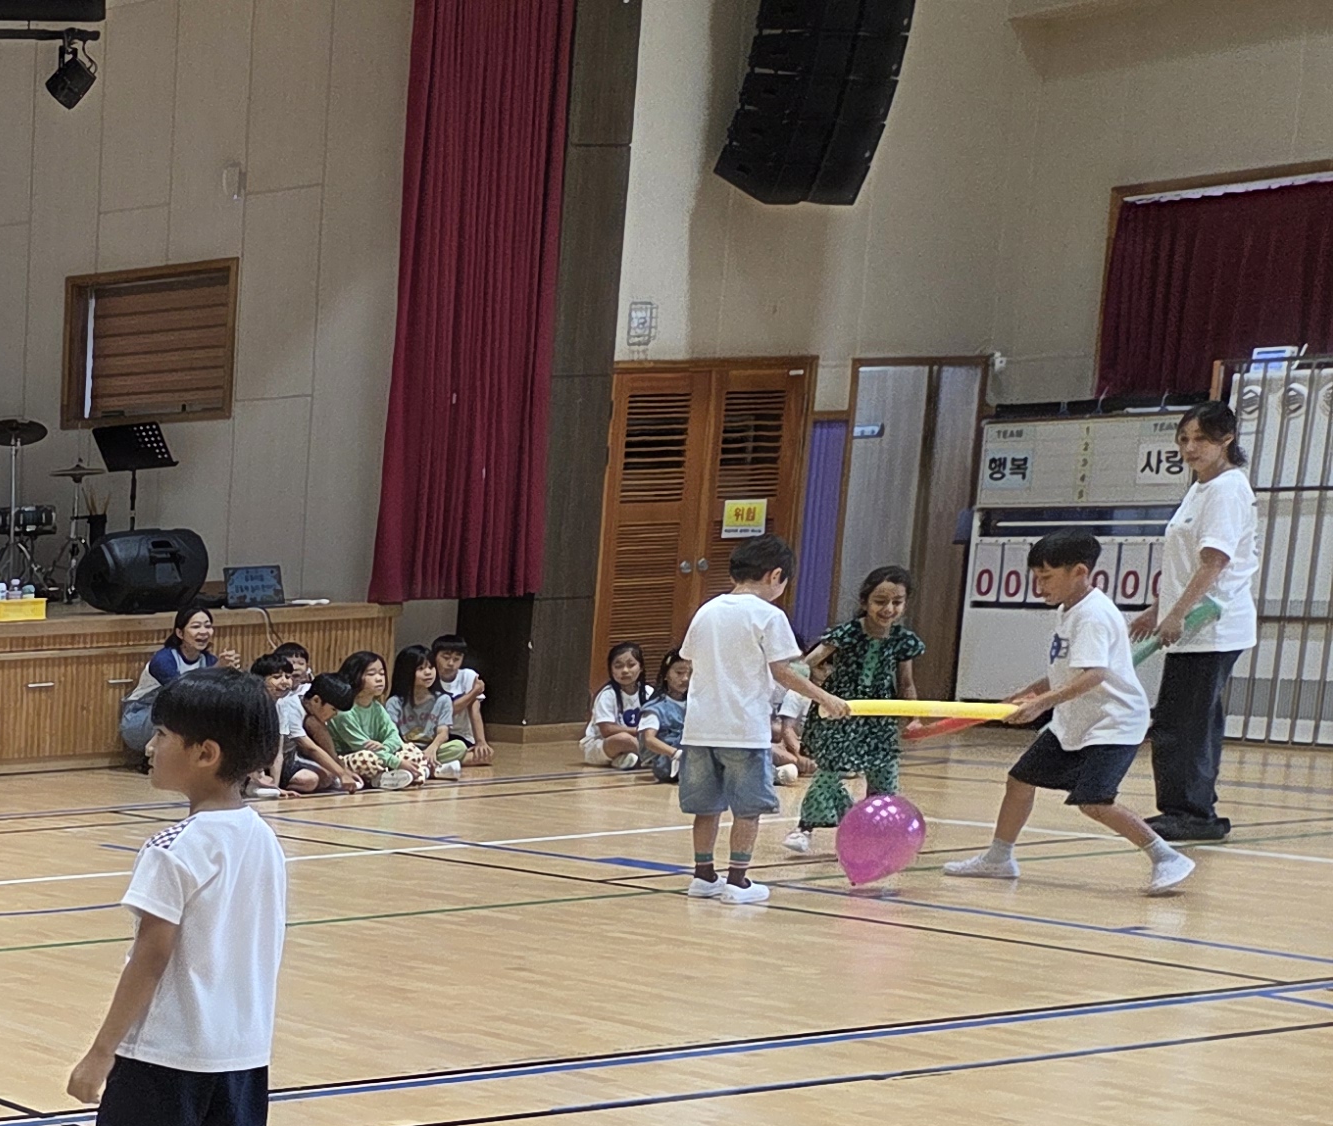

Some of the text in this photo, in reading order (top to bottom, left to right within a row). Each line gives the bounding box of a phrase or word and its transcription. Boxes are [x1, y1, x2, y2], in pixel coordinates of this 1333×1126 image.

[996, 429, 1024, 440] TEAM
[988, 455, 1028, 481] 행복
[1140, 449, 1184, 475] 사랑
